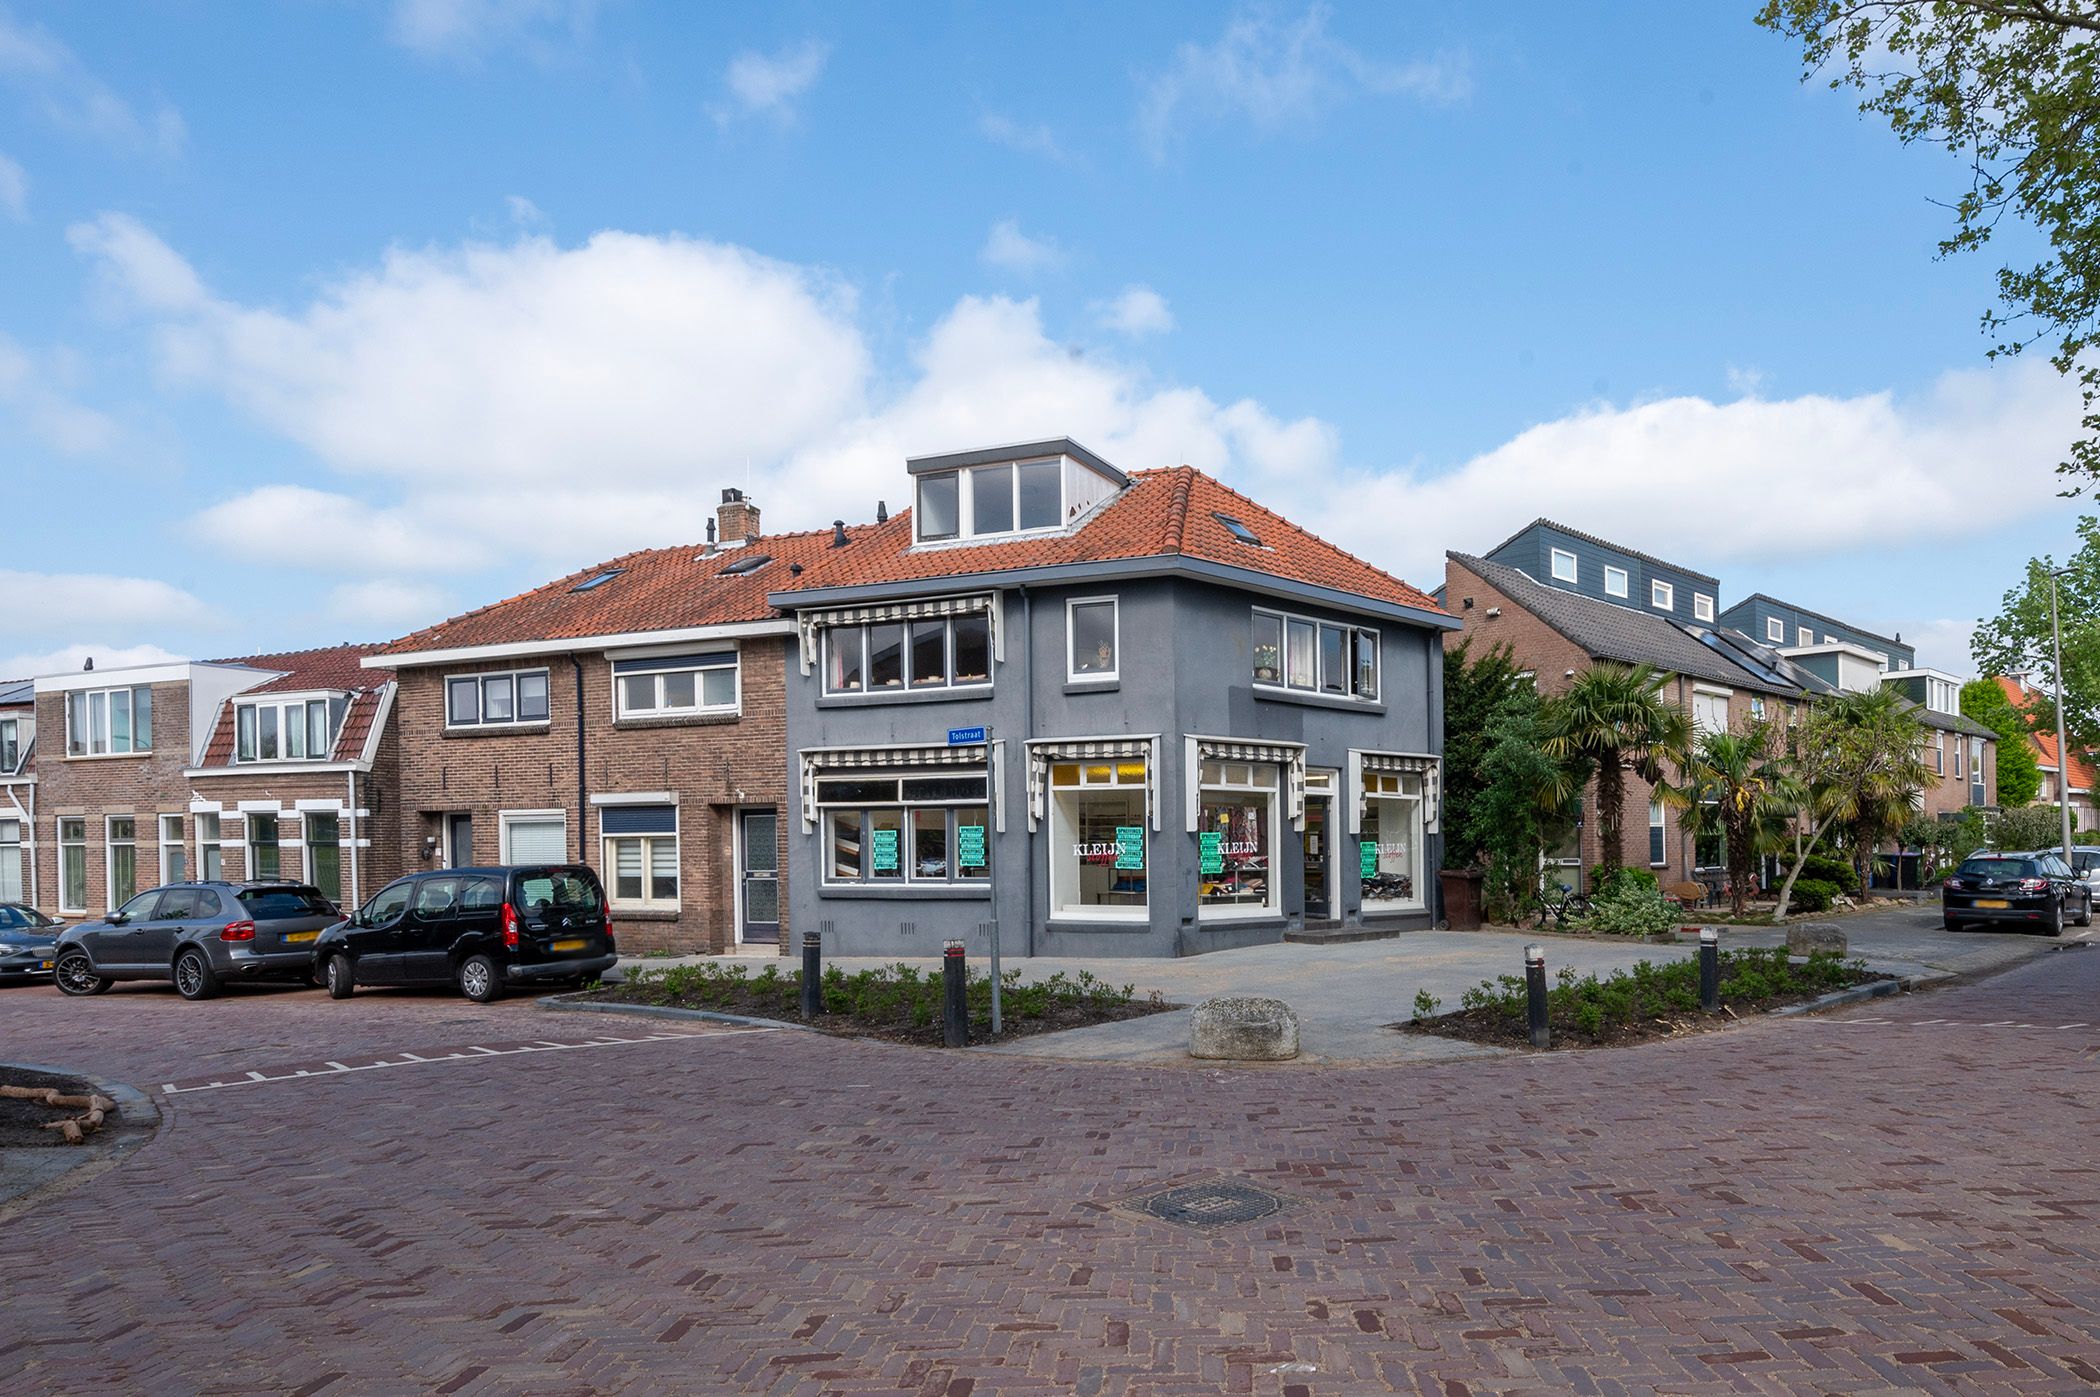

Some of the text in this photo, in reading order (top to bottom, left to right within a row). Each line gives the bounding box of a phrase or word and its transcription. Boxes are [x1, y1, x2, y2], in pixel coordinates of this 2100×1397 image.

[951, 731, 981, 740] Tolstraat
[1072, 842, 1126, 856] KLEIJN
[1217, 841, 1257, 855] KLEIJN
[1375, 843, 1406, 854] KLEIJN
